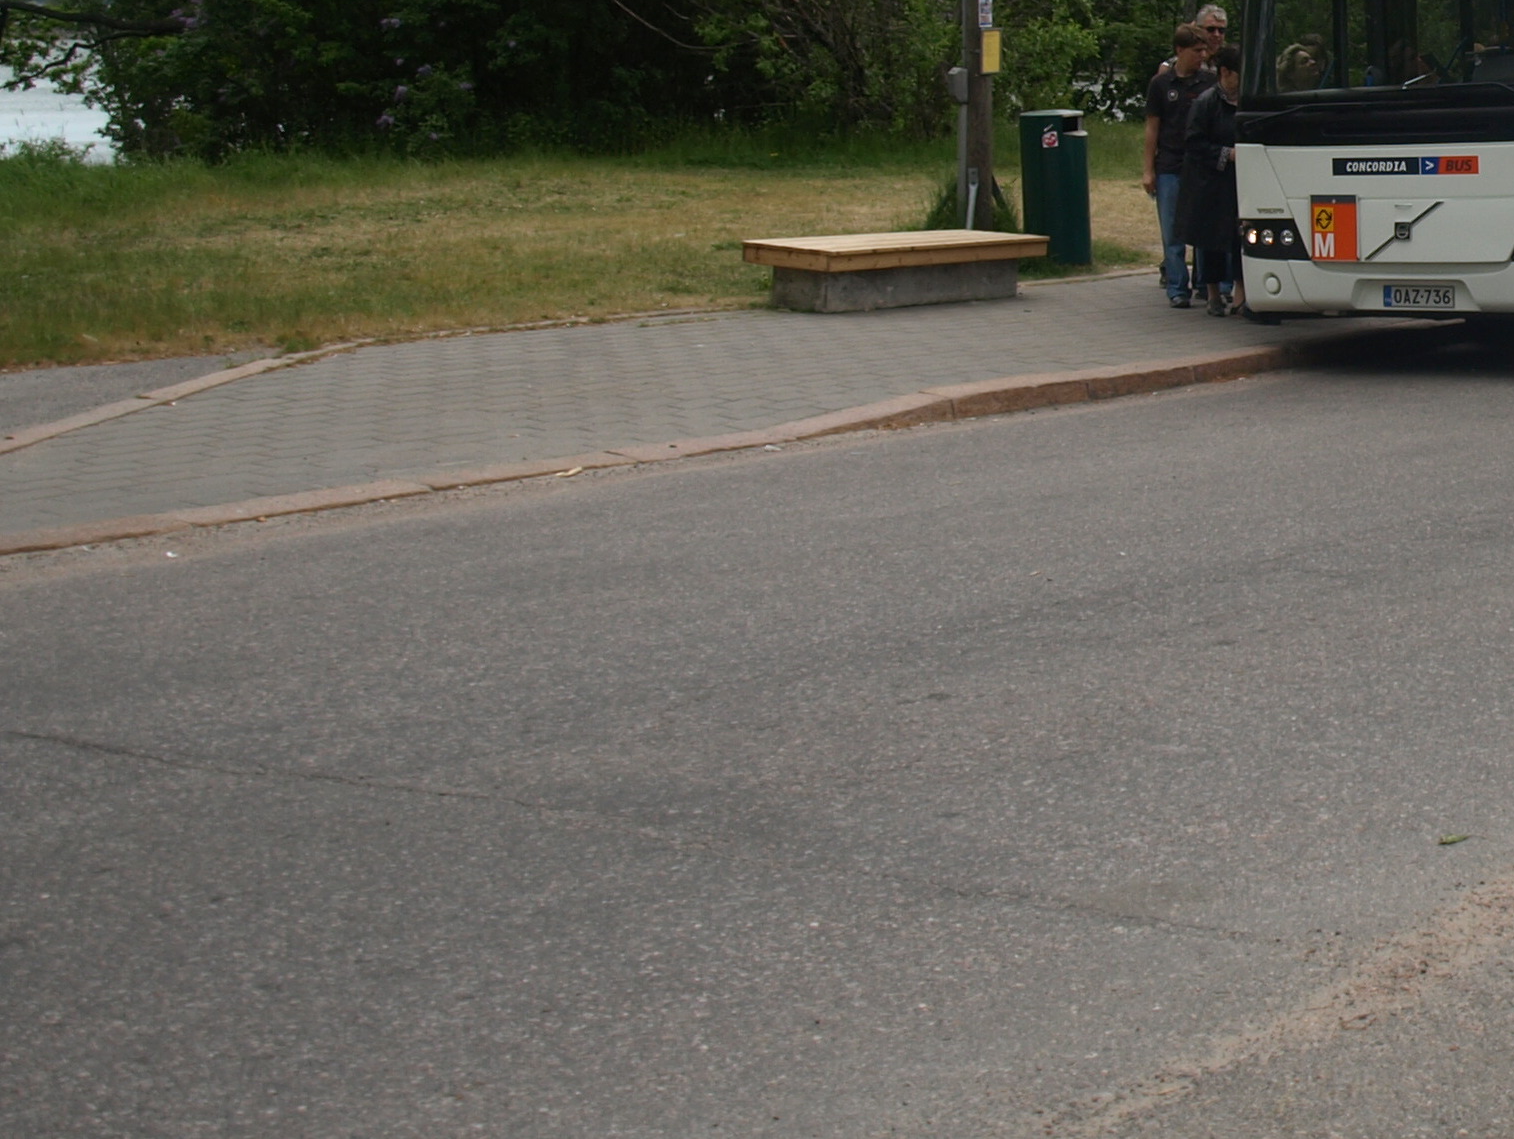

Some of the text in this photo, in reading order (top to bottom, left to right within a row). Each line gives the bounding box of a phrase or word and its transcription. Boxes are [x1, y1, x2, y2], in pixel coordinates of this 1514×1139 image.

[1345, 158, 1473, 173] CONCORDIA BUS
[1314, 232, 1335, 258] M
